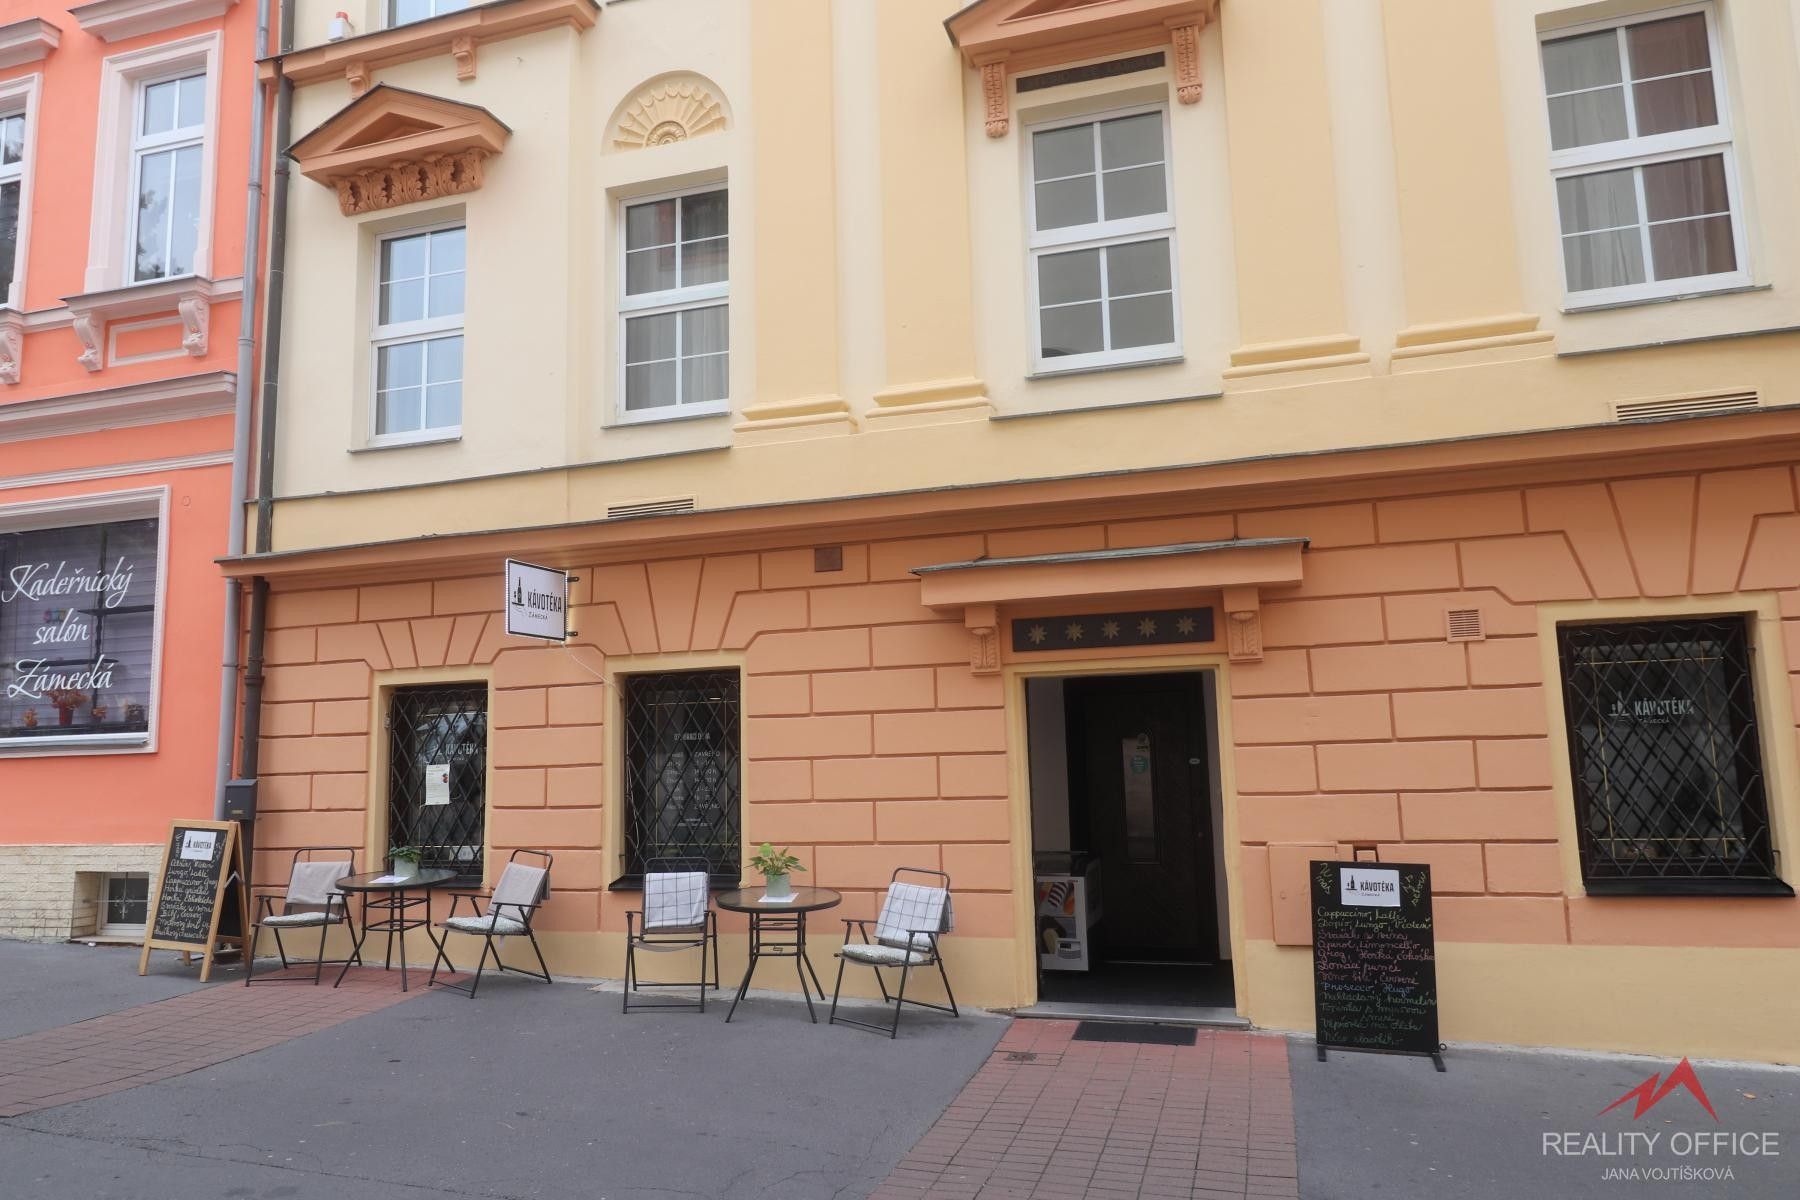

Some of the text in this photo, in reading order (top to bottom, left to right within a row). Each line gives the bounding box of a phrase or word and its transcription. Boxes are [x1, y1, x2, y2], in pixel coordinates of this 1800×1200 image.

[1, 556, 134, 608] Kadeřnický
[528, 589, 562, 613] KÁVOTÉKA
[32, 608, 90, 644] salón
[8, 654, 114, 699] Zámecká
[1360, 880, 1394, 892] KÁVOTÉKA
